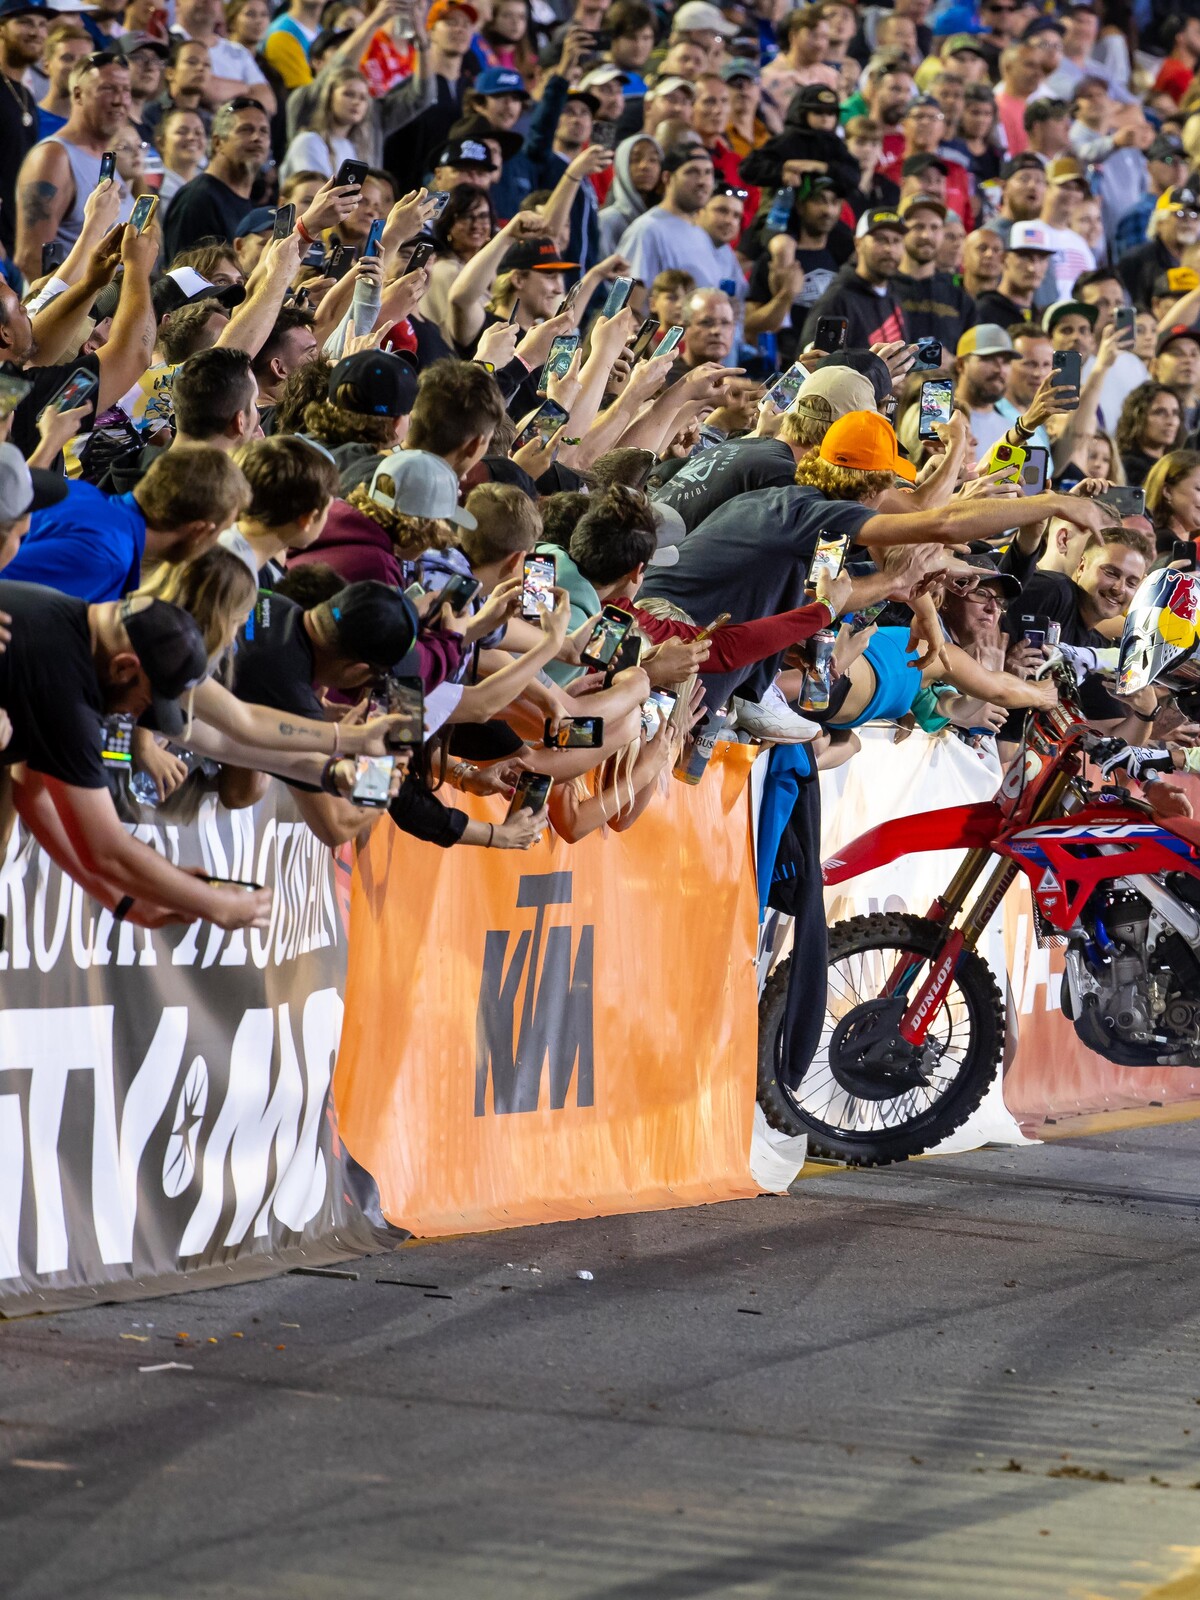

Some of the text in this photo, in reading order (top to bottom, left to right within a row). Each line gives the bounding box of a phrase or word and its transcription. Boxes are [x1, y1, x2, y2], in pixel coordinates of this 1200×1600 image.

[676, 483, 709, 501] PRIDE
[1010, 824, 1161, 839] CRF
[474, 870, 595, 1118] KTM
[910, 956, 953, 1032] DUNLOP
